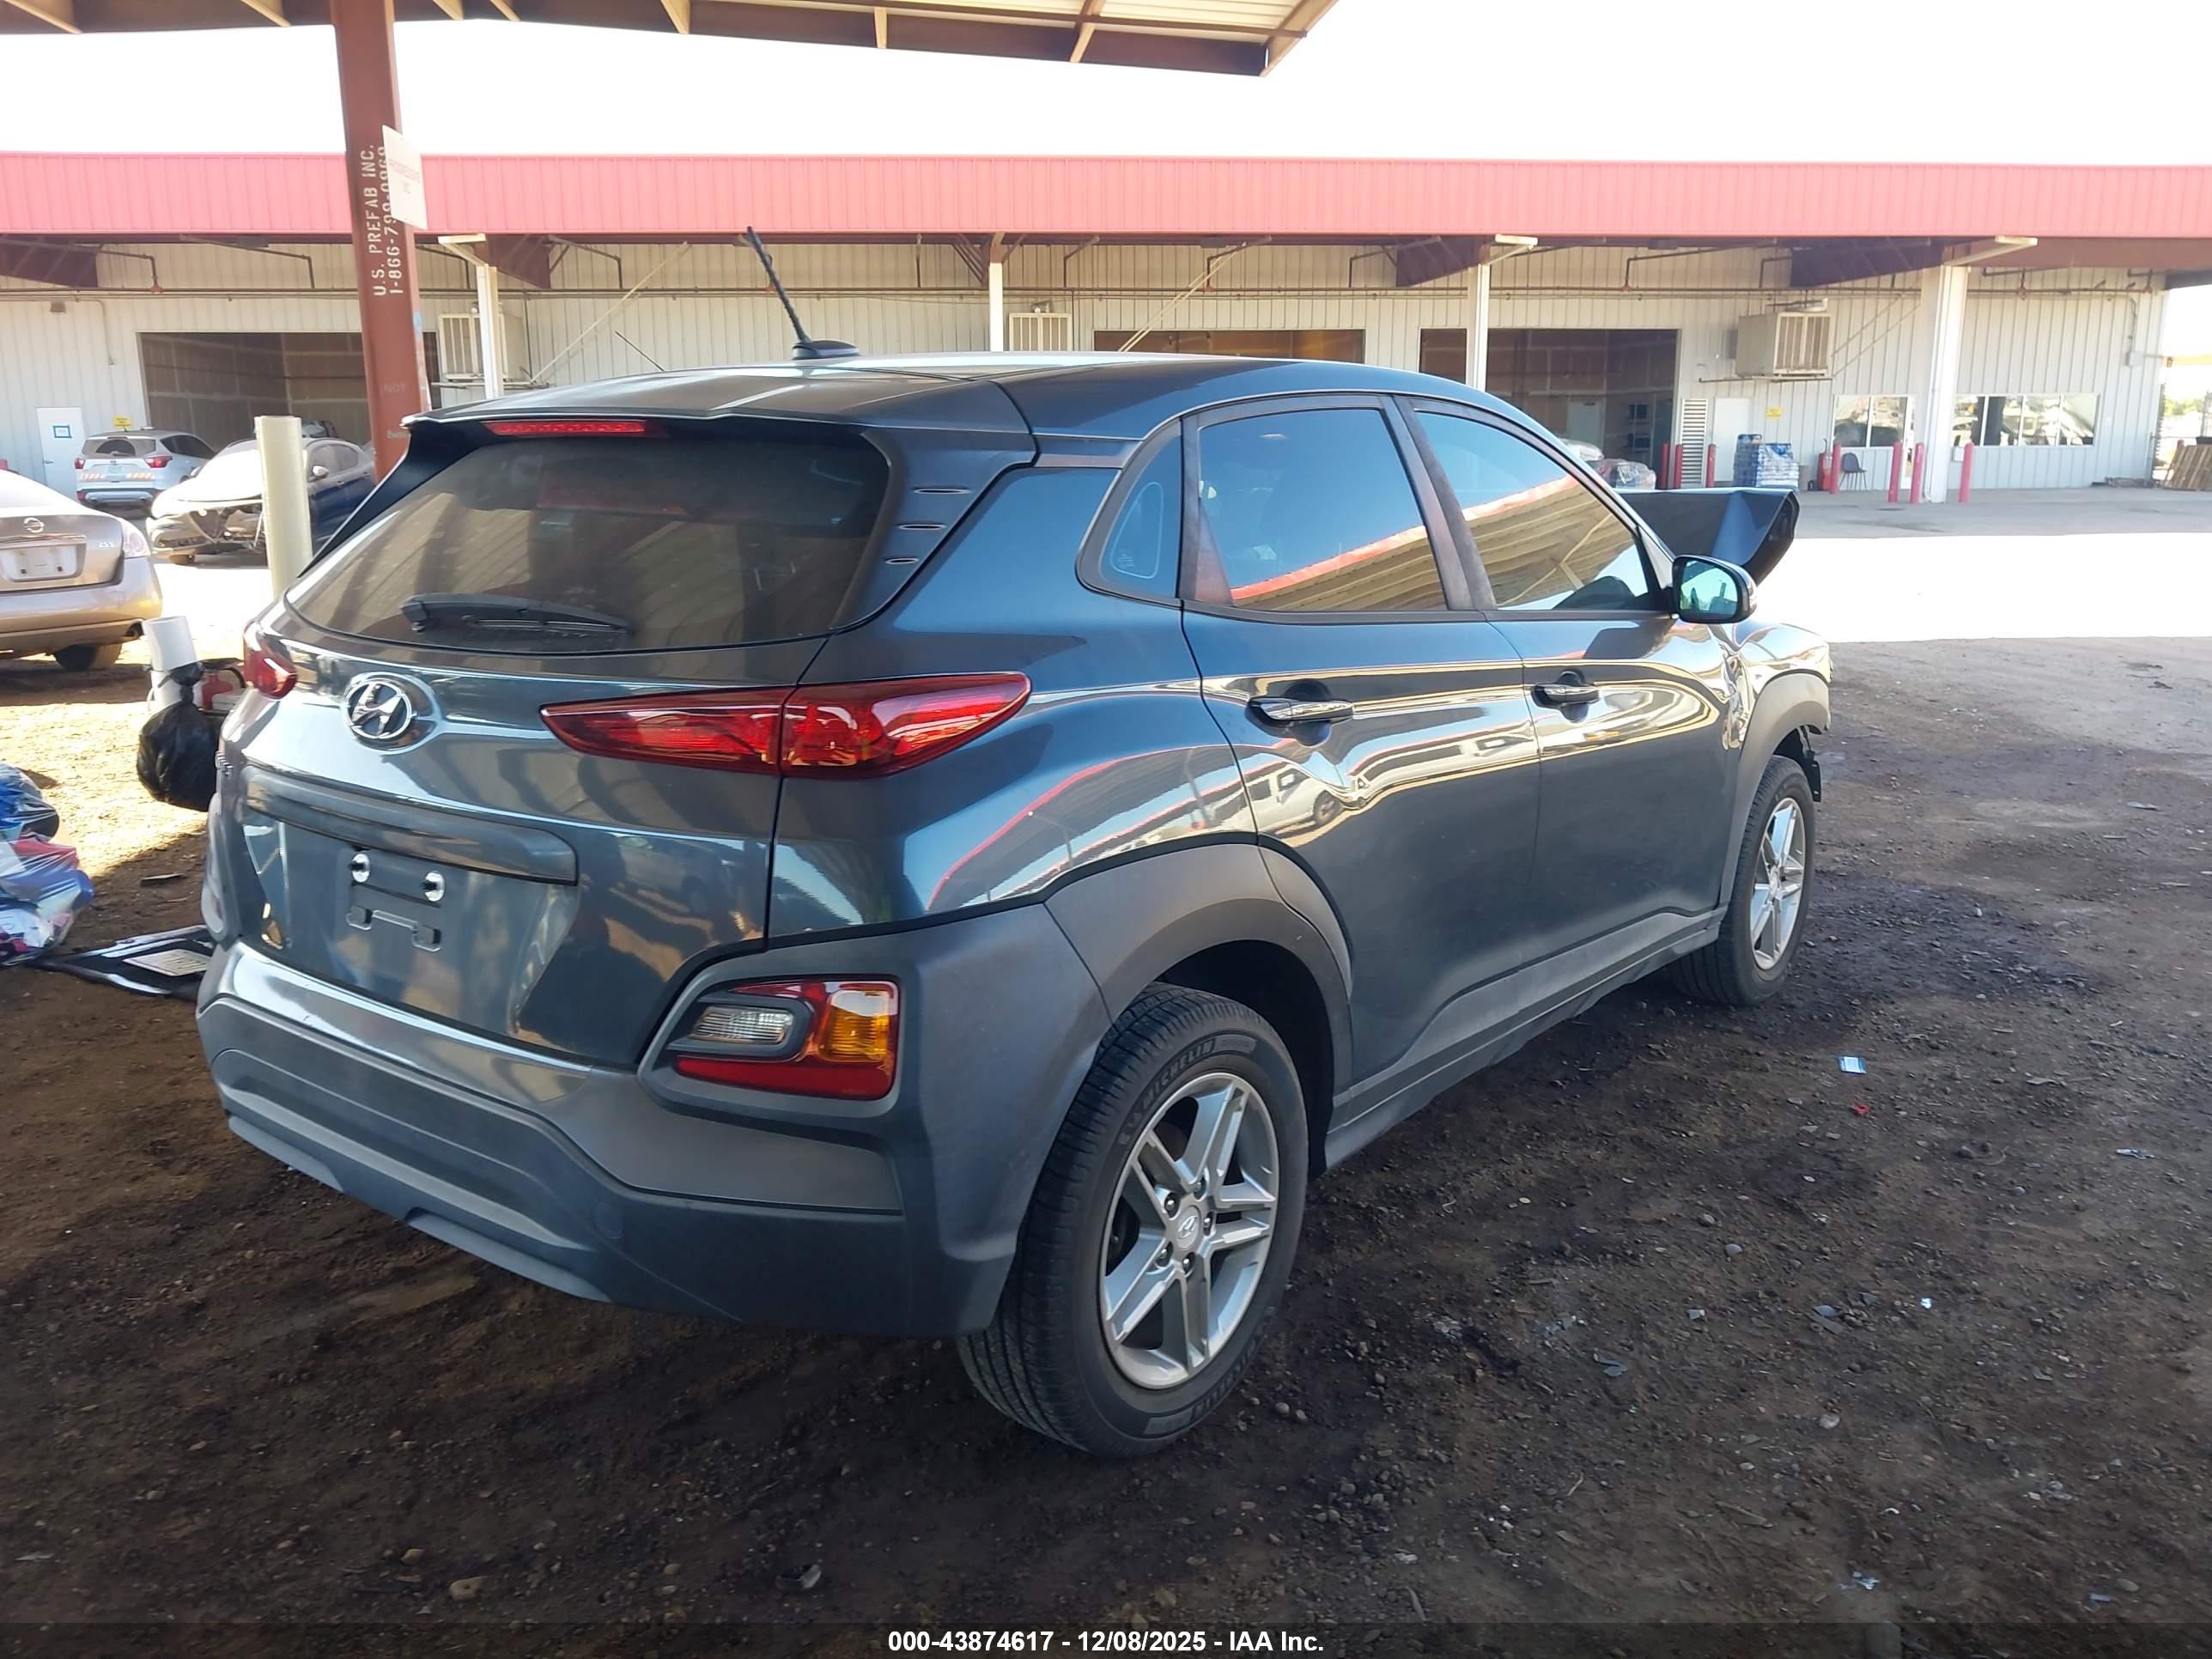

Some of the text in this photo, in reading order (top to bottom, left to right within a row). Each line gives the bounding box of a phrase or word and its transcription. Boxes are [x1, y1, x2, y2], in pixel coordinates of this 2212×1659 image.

[359, 144, 386, 296] U.S. PREFAB INC.
